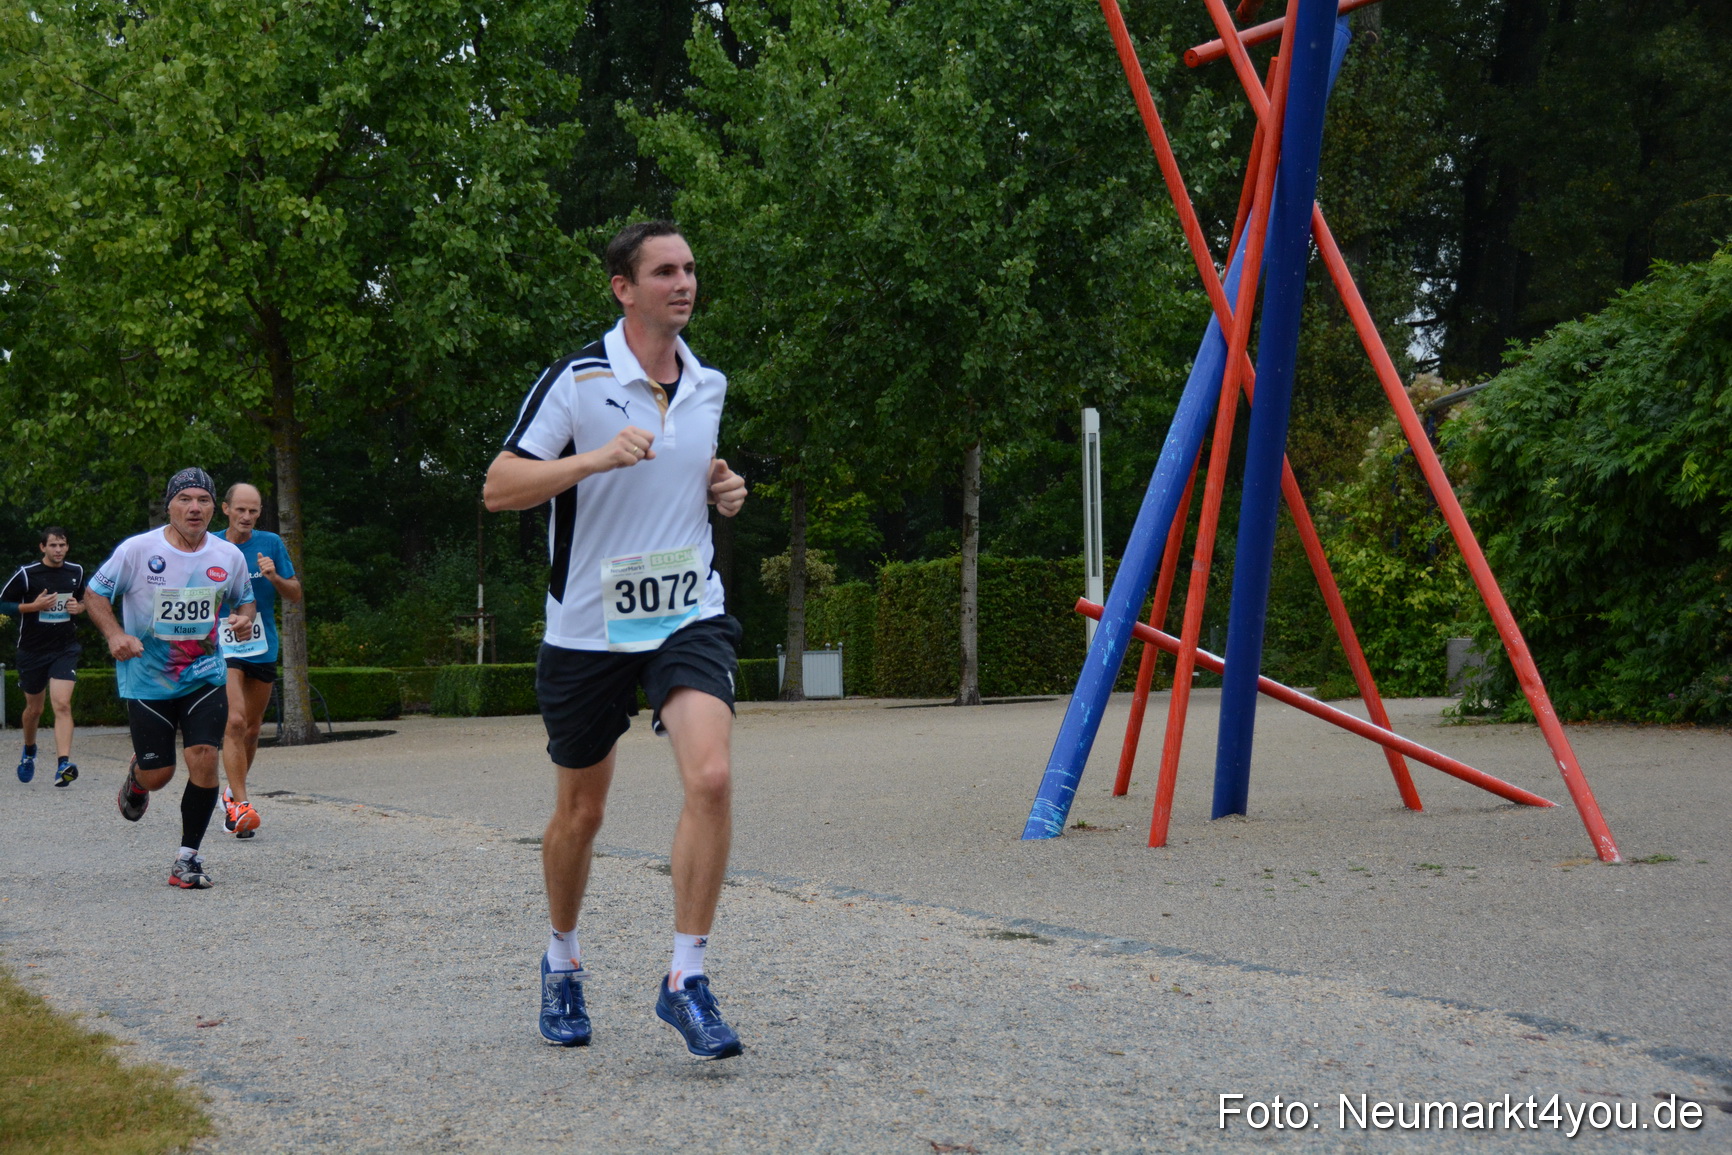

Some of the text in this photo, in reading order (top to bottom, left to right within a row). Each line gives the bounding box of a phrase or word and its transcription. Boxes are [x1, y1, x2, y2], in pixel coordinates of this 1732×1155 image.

[650, 549, 694, 566] BOCK
[610, 565, 645, 574] NeuerMarkt
[615, 570, 698, 614] 3072
[161, 600, 210, 621] 2398
[174, 626, 197, 634] Klaus
[224, 623, 261, 643] 39
